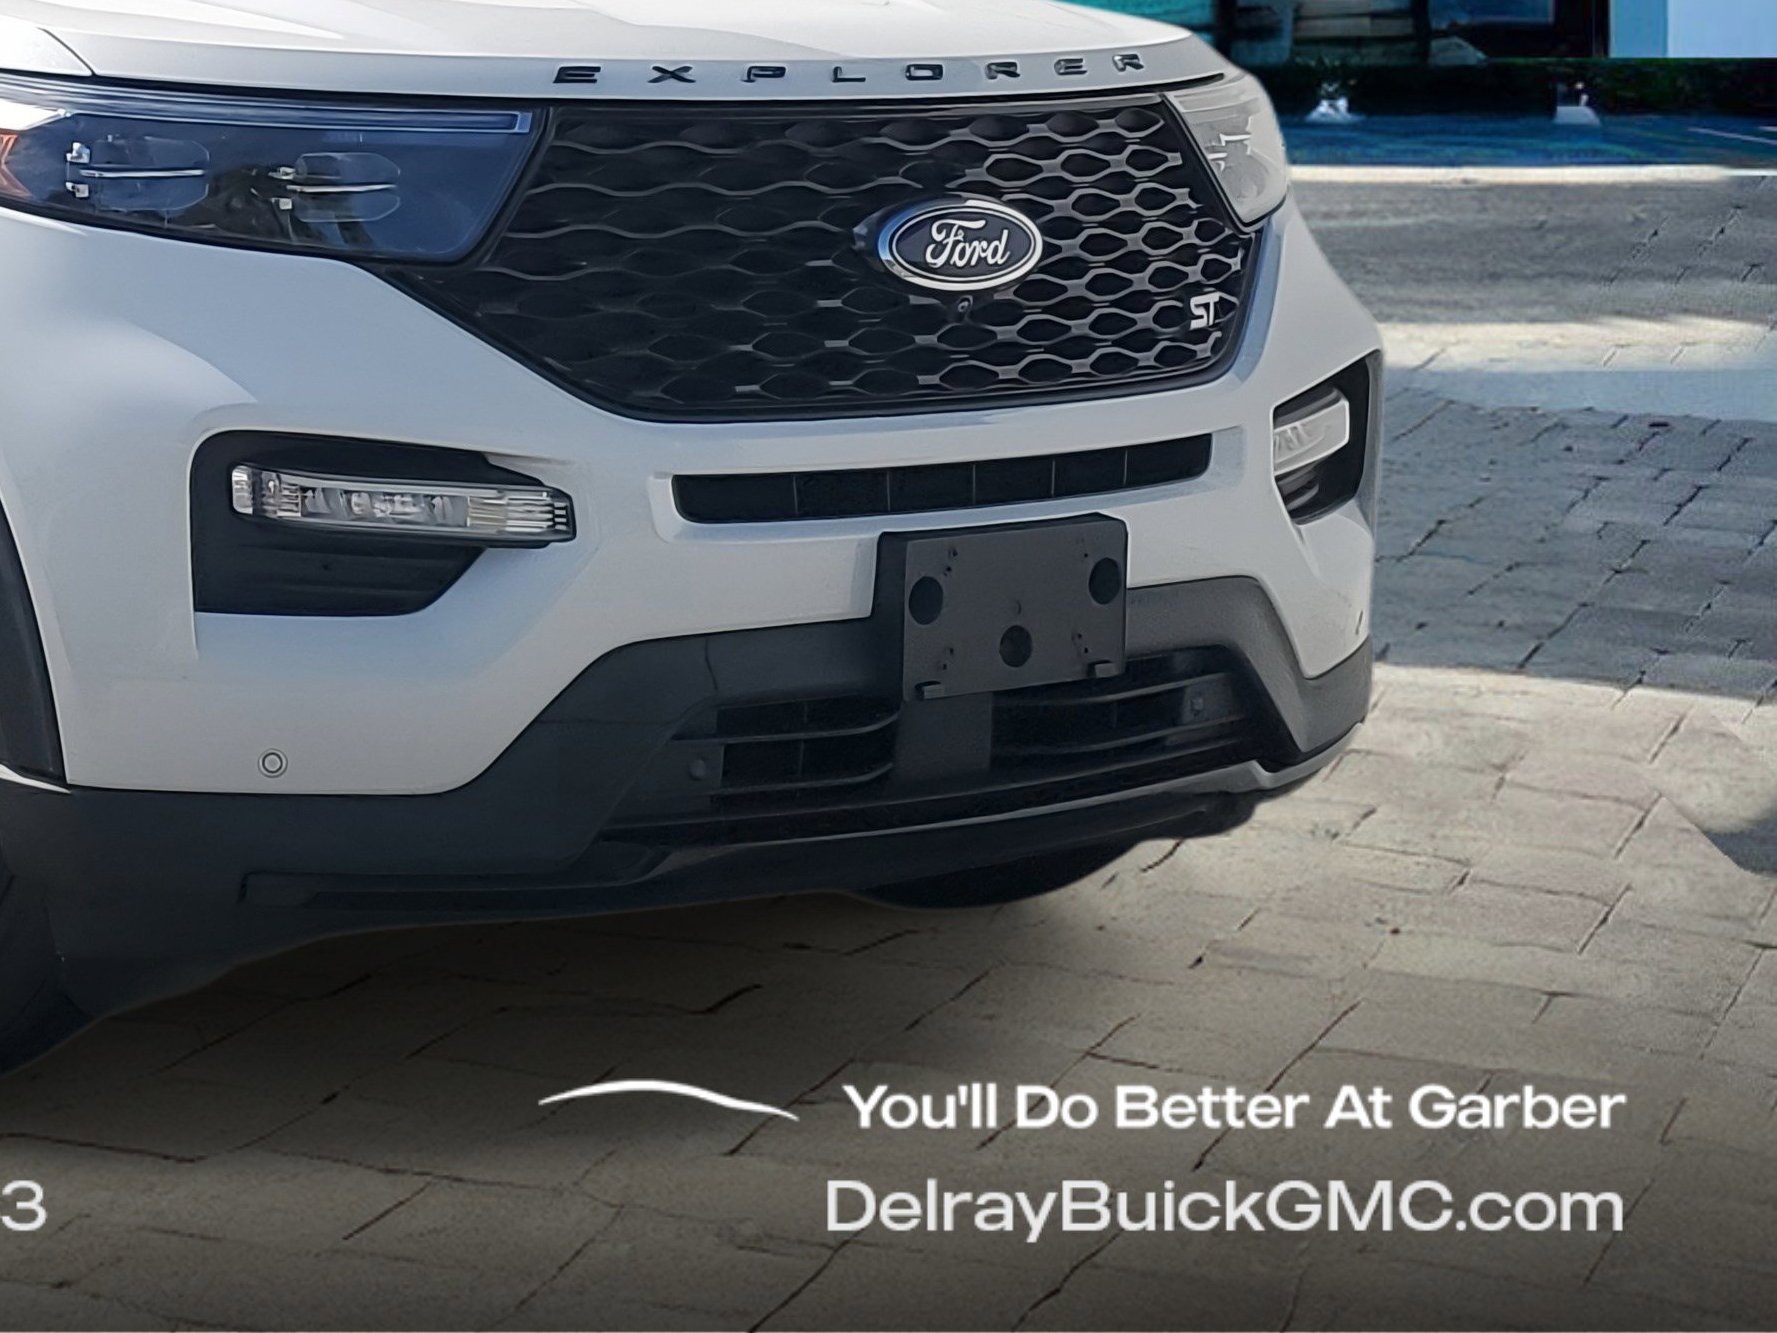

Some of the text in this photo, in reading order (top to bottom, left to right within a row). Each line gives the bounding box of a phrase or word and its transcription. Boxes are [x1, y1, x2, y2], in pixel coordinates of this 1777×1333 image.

[553, 53, 1145, 84] EXPLORER
[925, 219, 1011, 268] Ford
[1190, 292, 1220, 329] ST
